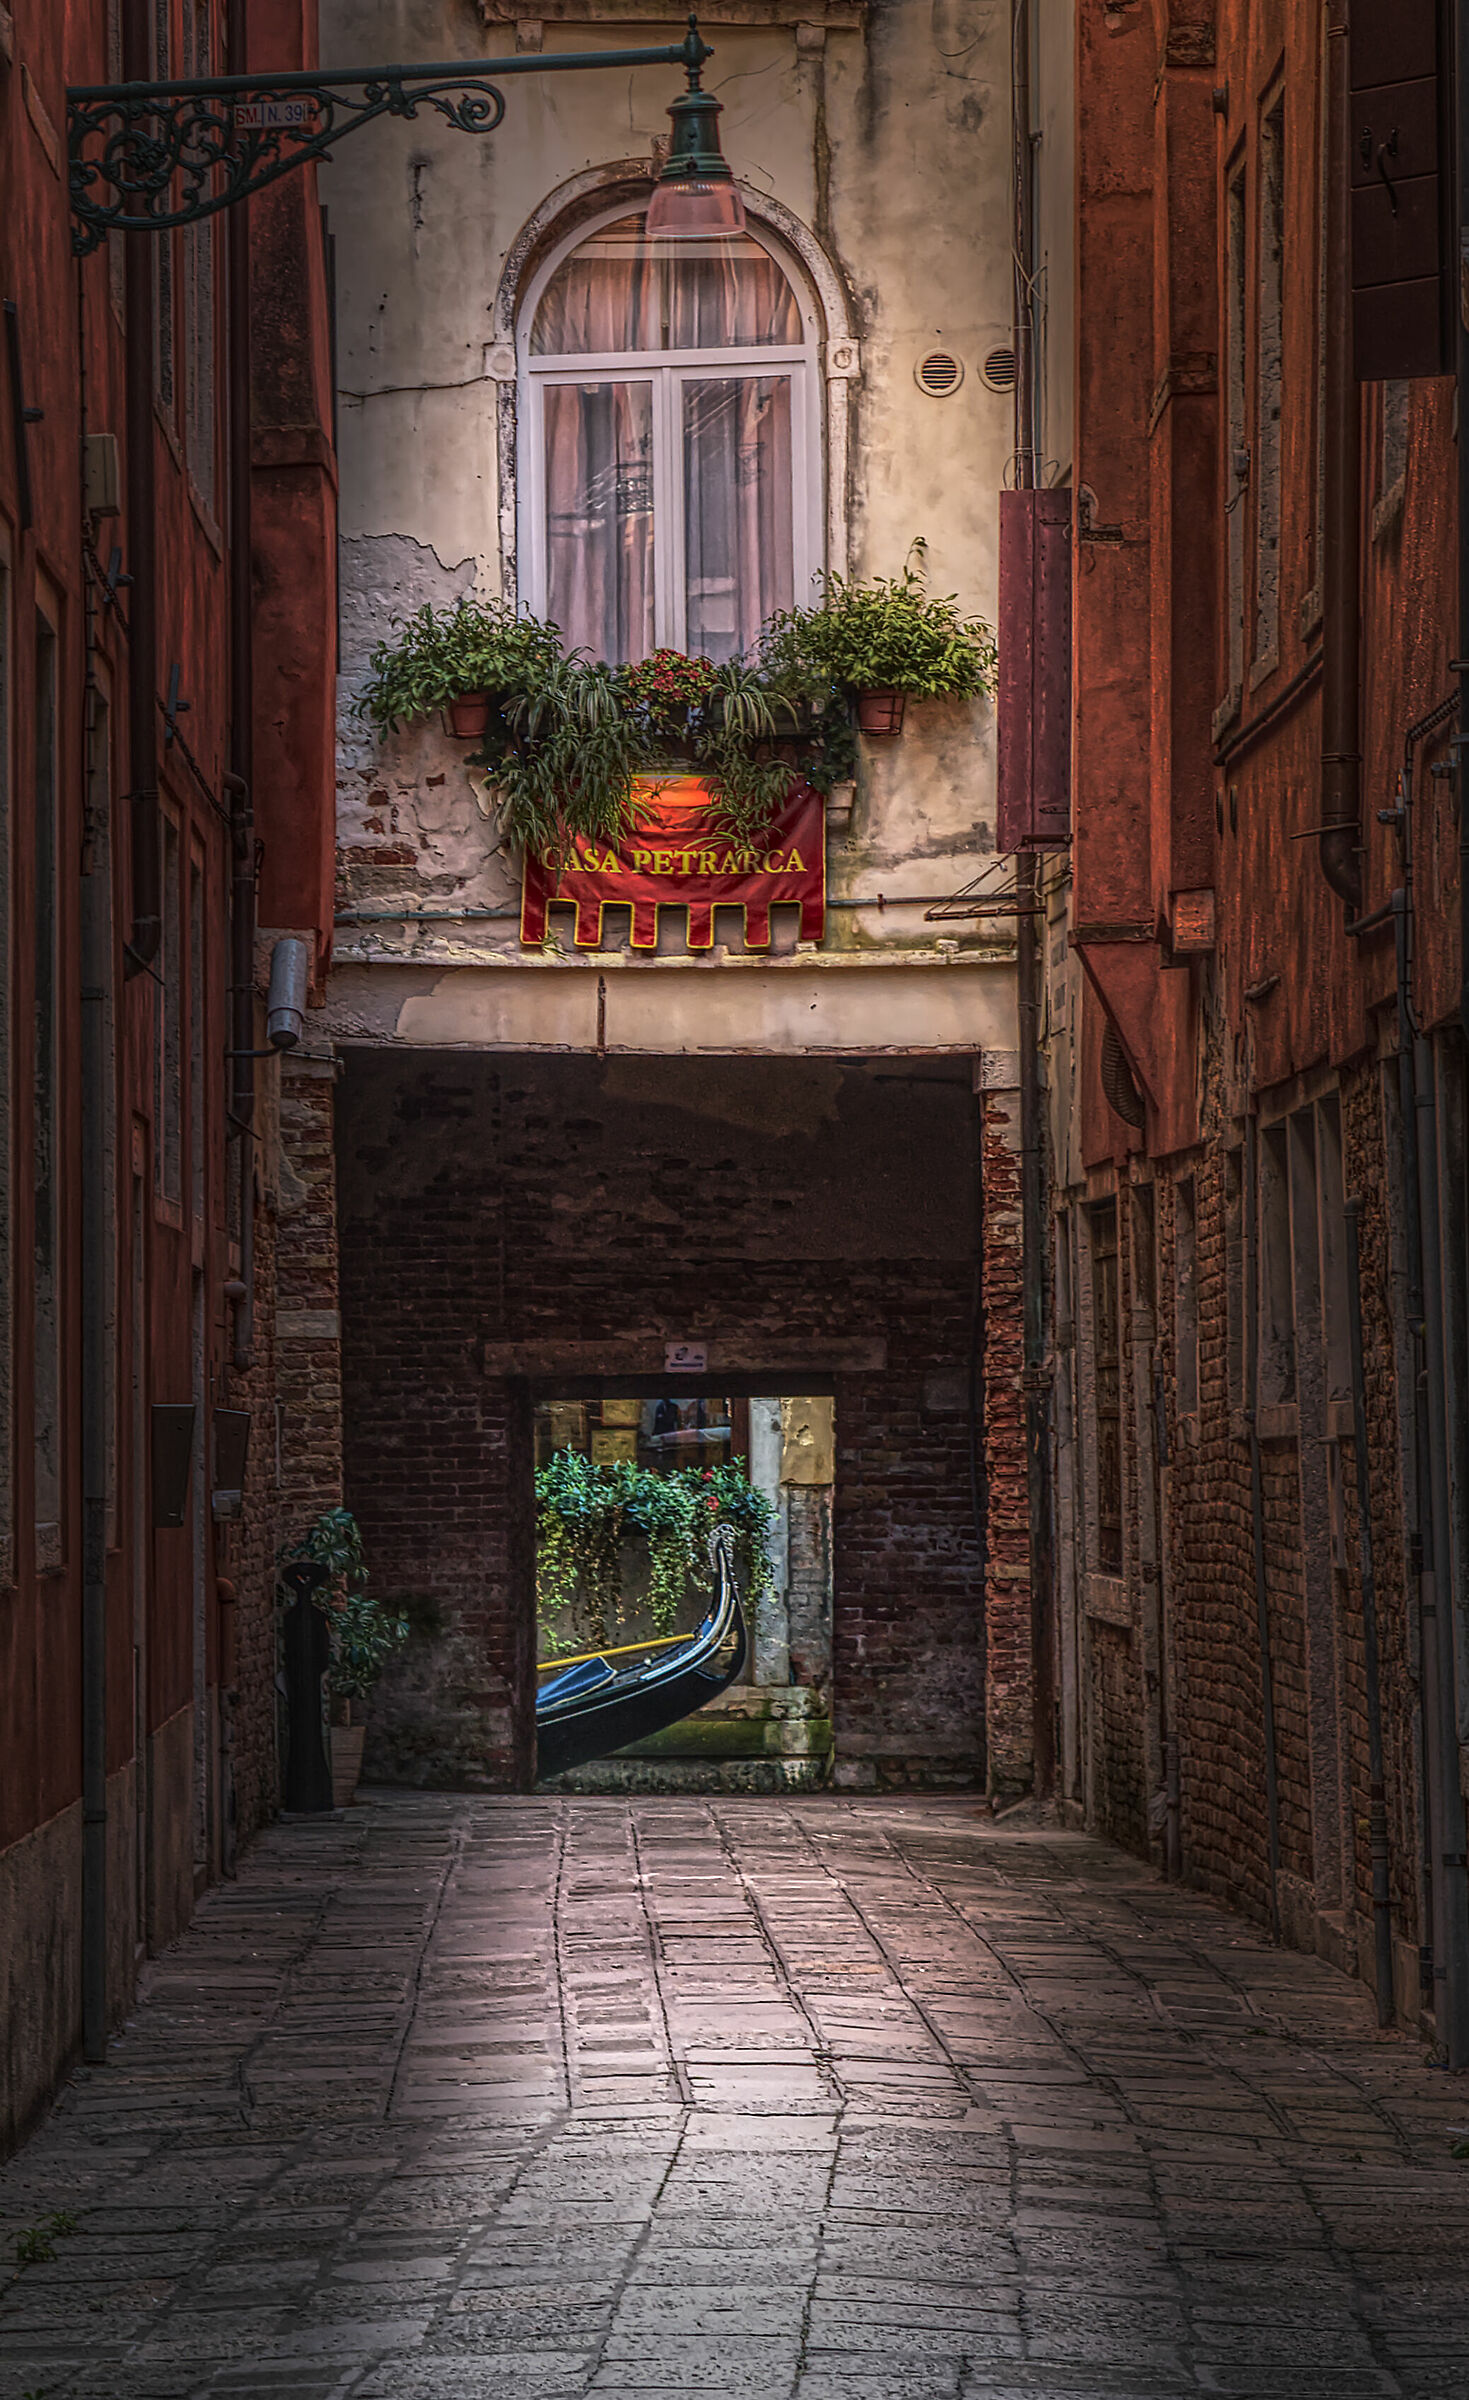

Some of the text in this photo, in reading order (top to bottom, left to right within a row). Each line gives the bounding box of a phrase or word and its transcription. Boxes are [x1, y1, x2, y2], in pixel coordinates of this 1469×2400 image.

[268, 105, 282, 122] N.
[541, 846, 808, 875] CASA PETRARCA
